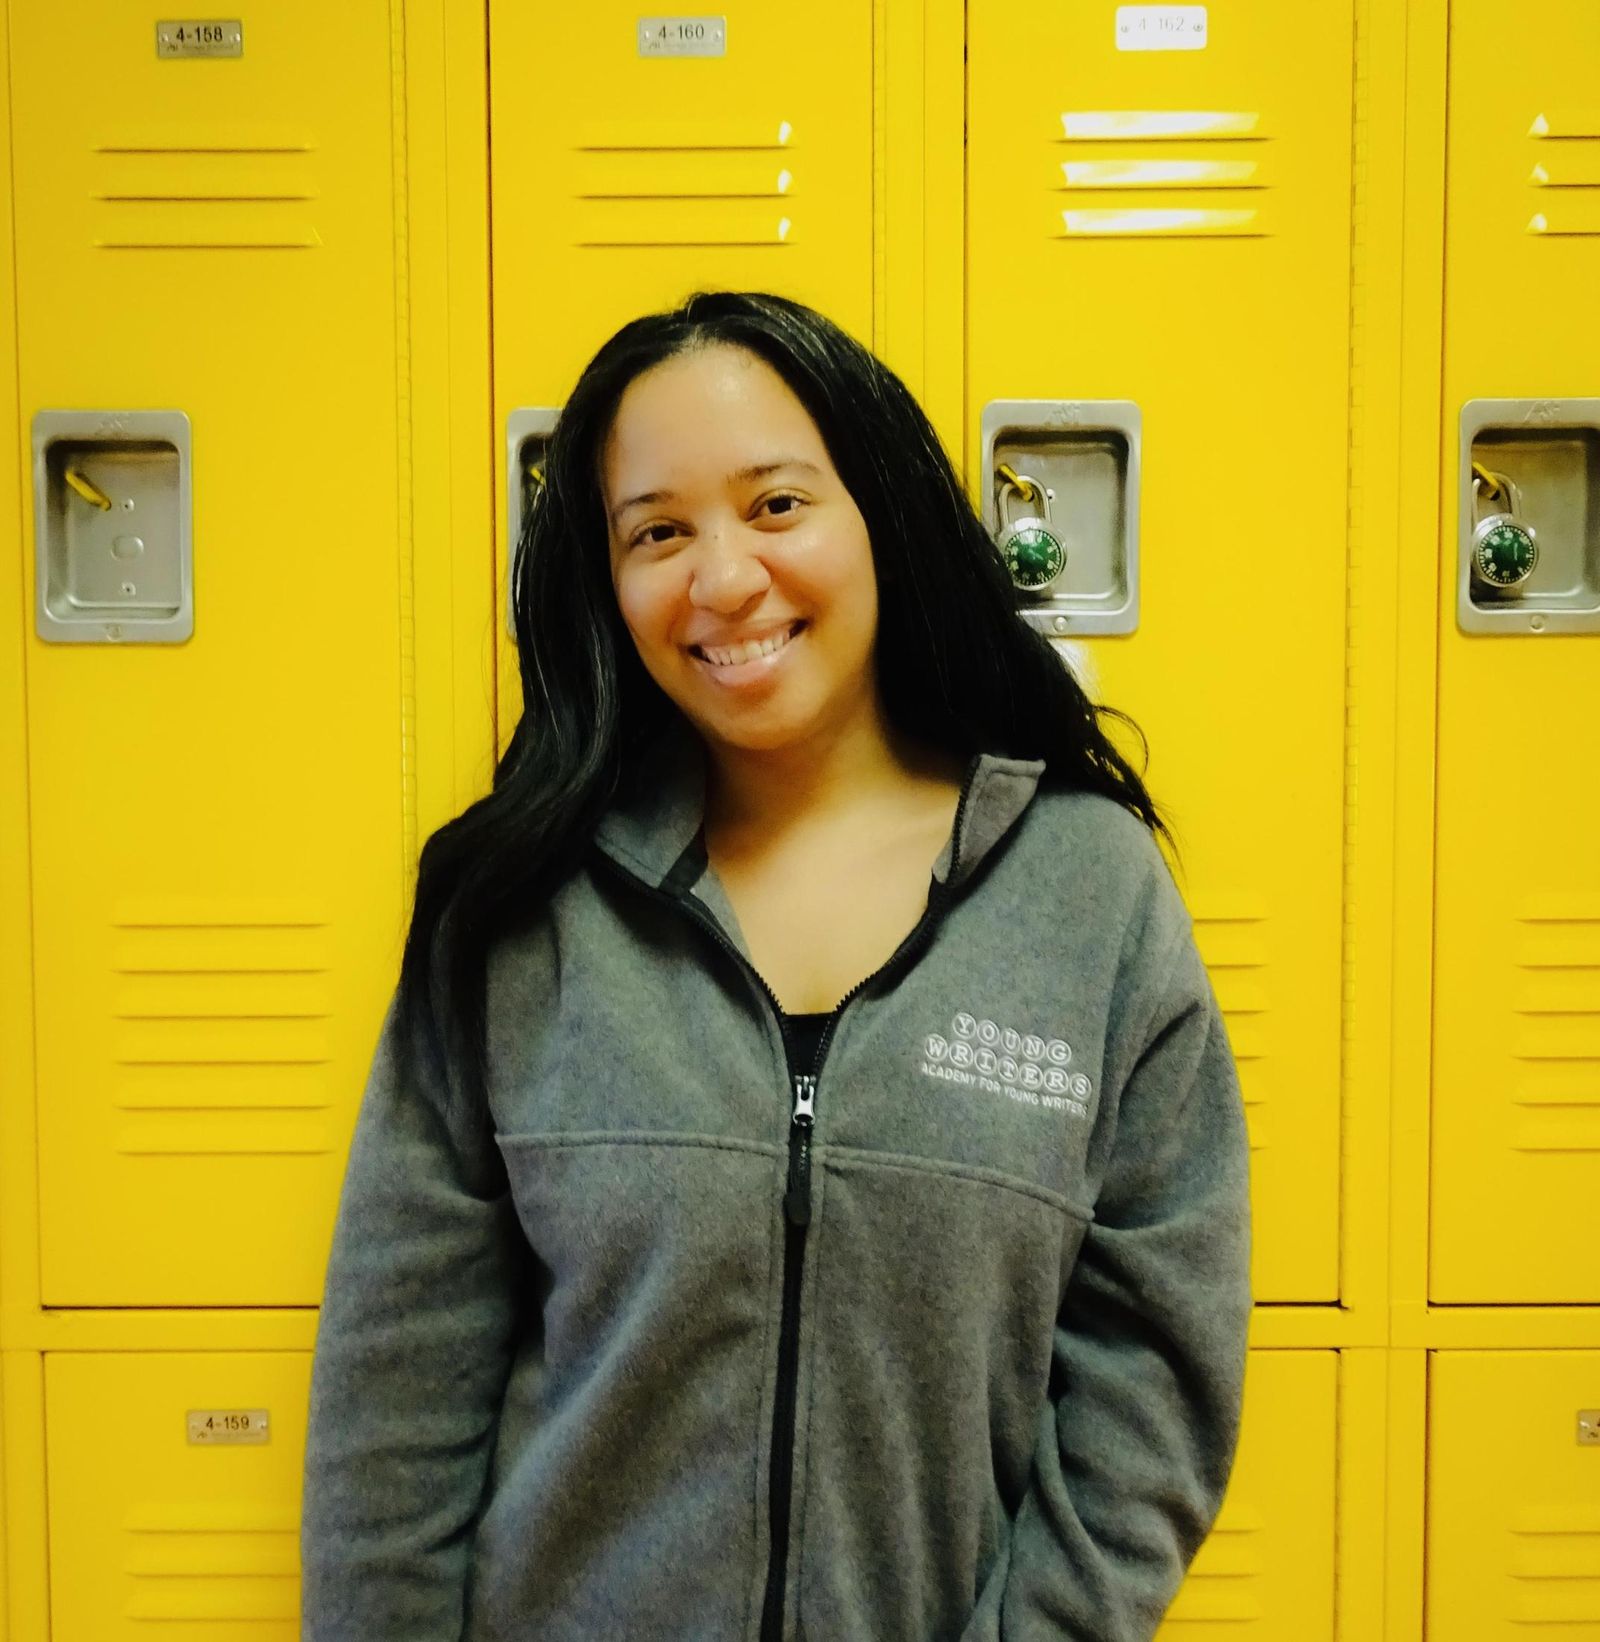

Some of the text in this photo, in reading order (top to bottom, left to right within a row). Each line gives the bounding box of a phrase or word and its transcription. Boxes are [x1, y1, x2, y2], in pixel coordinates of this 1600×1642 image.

[176, 26, 223, 43] 4-158
[658, 23, 705, 40] 4-160
[952, 1012, 1072, 1066] YOUNG
[924, 1033, 1092, 1100] WRITERS
[921, 1062, 977, 1087] ACADEMY
[979, 1076, 1001, 1095] FOR
[1003, 1085, 1040, 1106] YOUNG
[206, 1415, 250, 1430] 4-159
